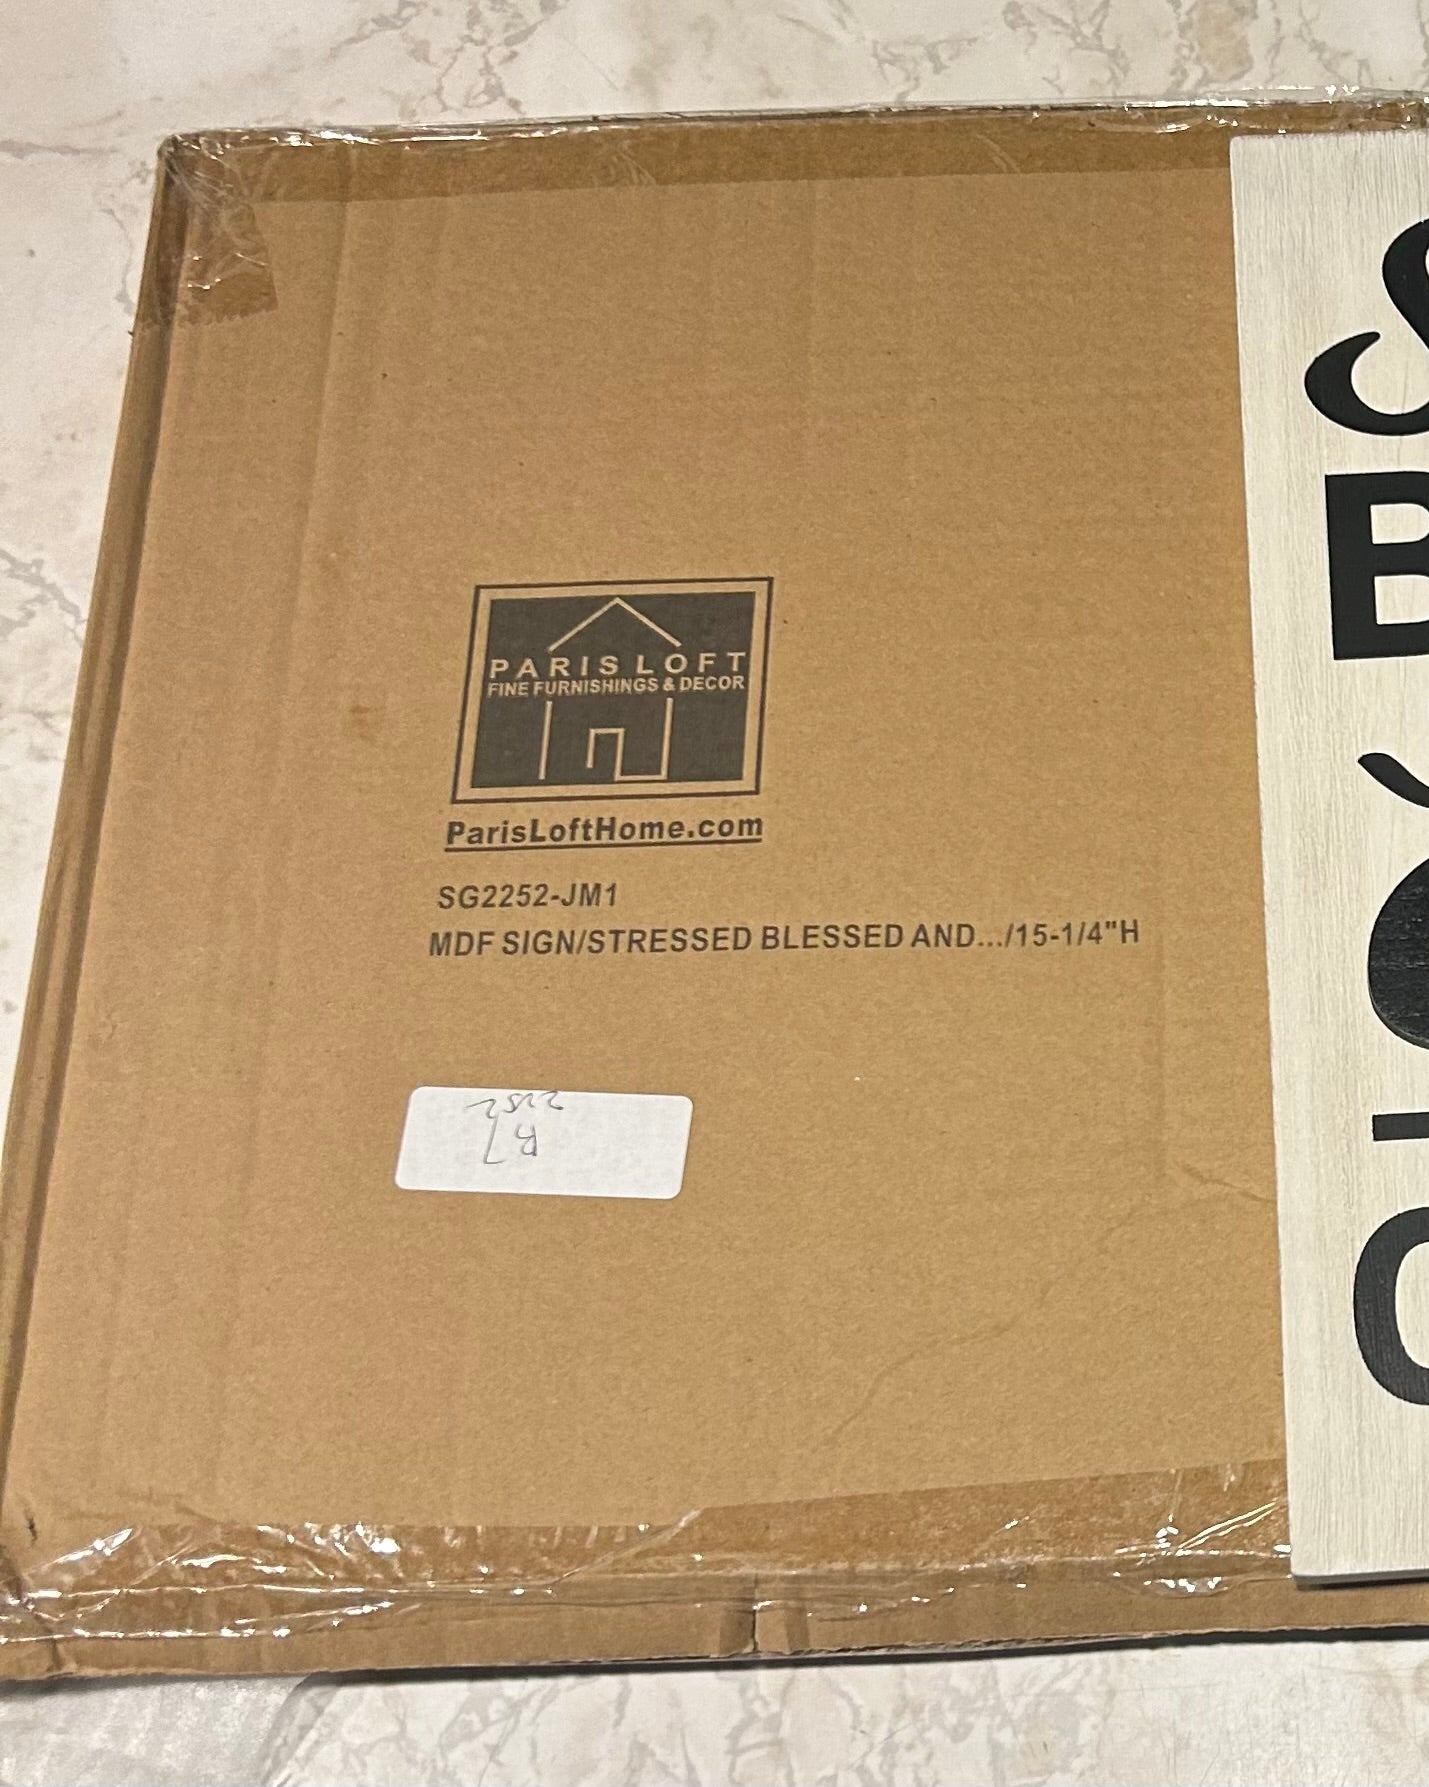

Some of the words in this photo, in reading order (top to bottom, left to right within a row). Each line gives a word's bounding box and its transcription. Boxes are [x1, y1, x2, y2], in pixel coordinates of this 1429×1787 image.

[488, 655, 619, 679] PARIS
[636, 651, 747, 675] LOFT
[487, 681, 529, 698] FINE
[532, 677, 659, 697] FURNISHINGS
[662, 675, 676, 692] &
[678, 675, 746, 692] DECOR
[446, 816, 764, 846] ParisLoftHome.com
[437, 882, 618, 910] SG2252-JM1
[428, 931, 495, 957] MDF
[501, 926, 752, 956] SIGN/STRESSED
[761, 924, 903, 950] BLESSED
